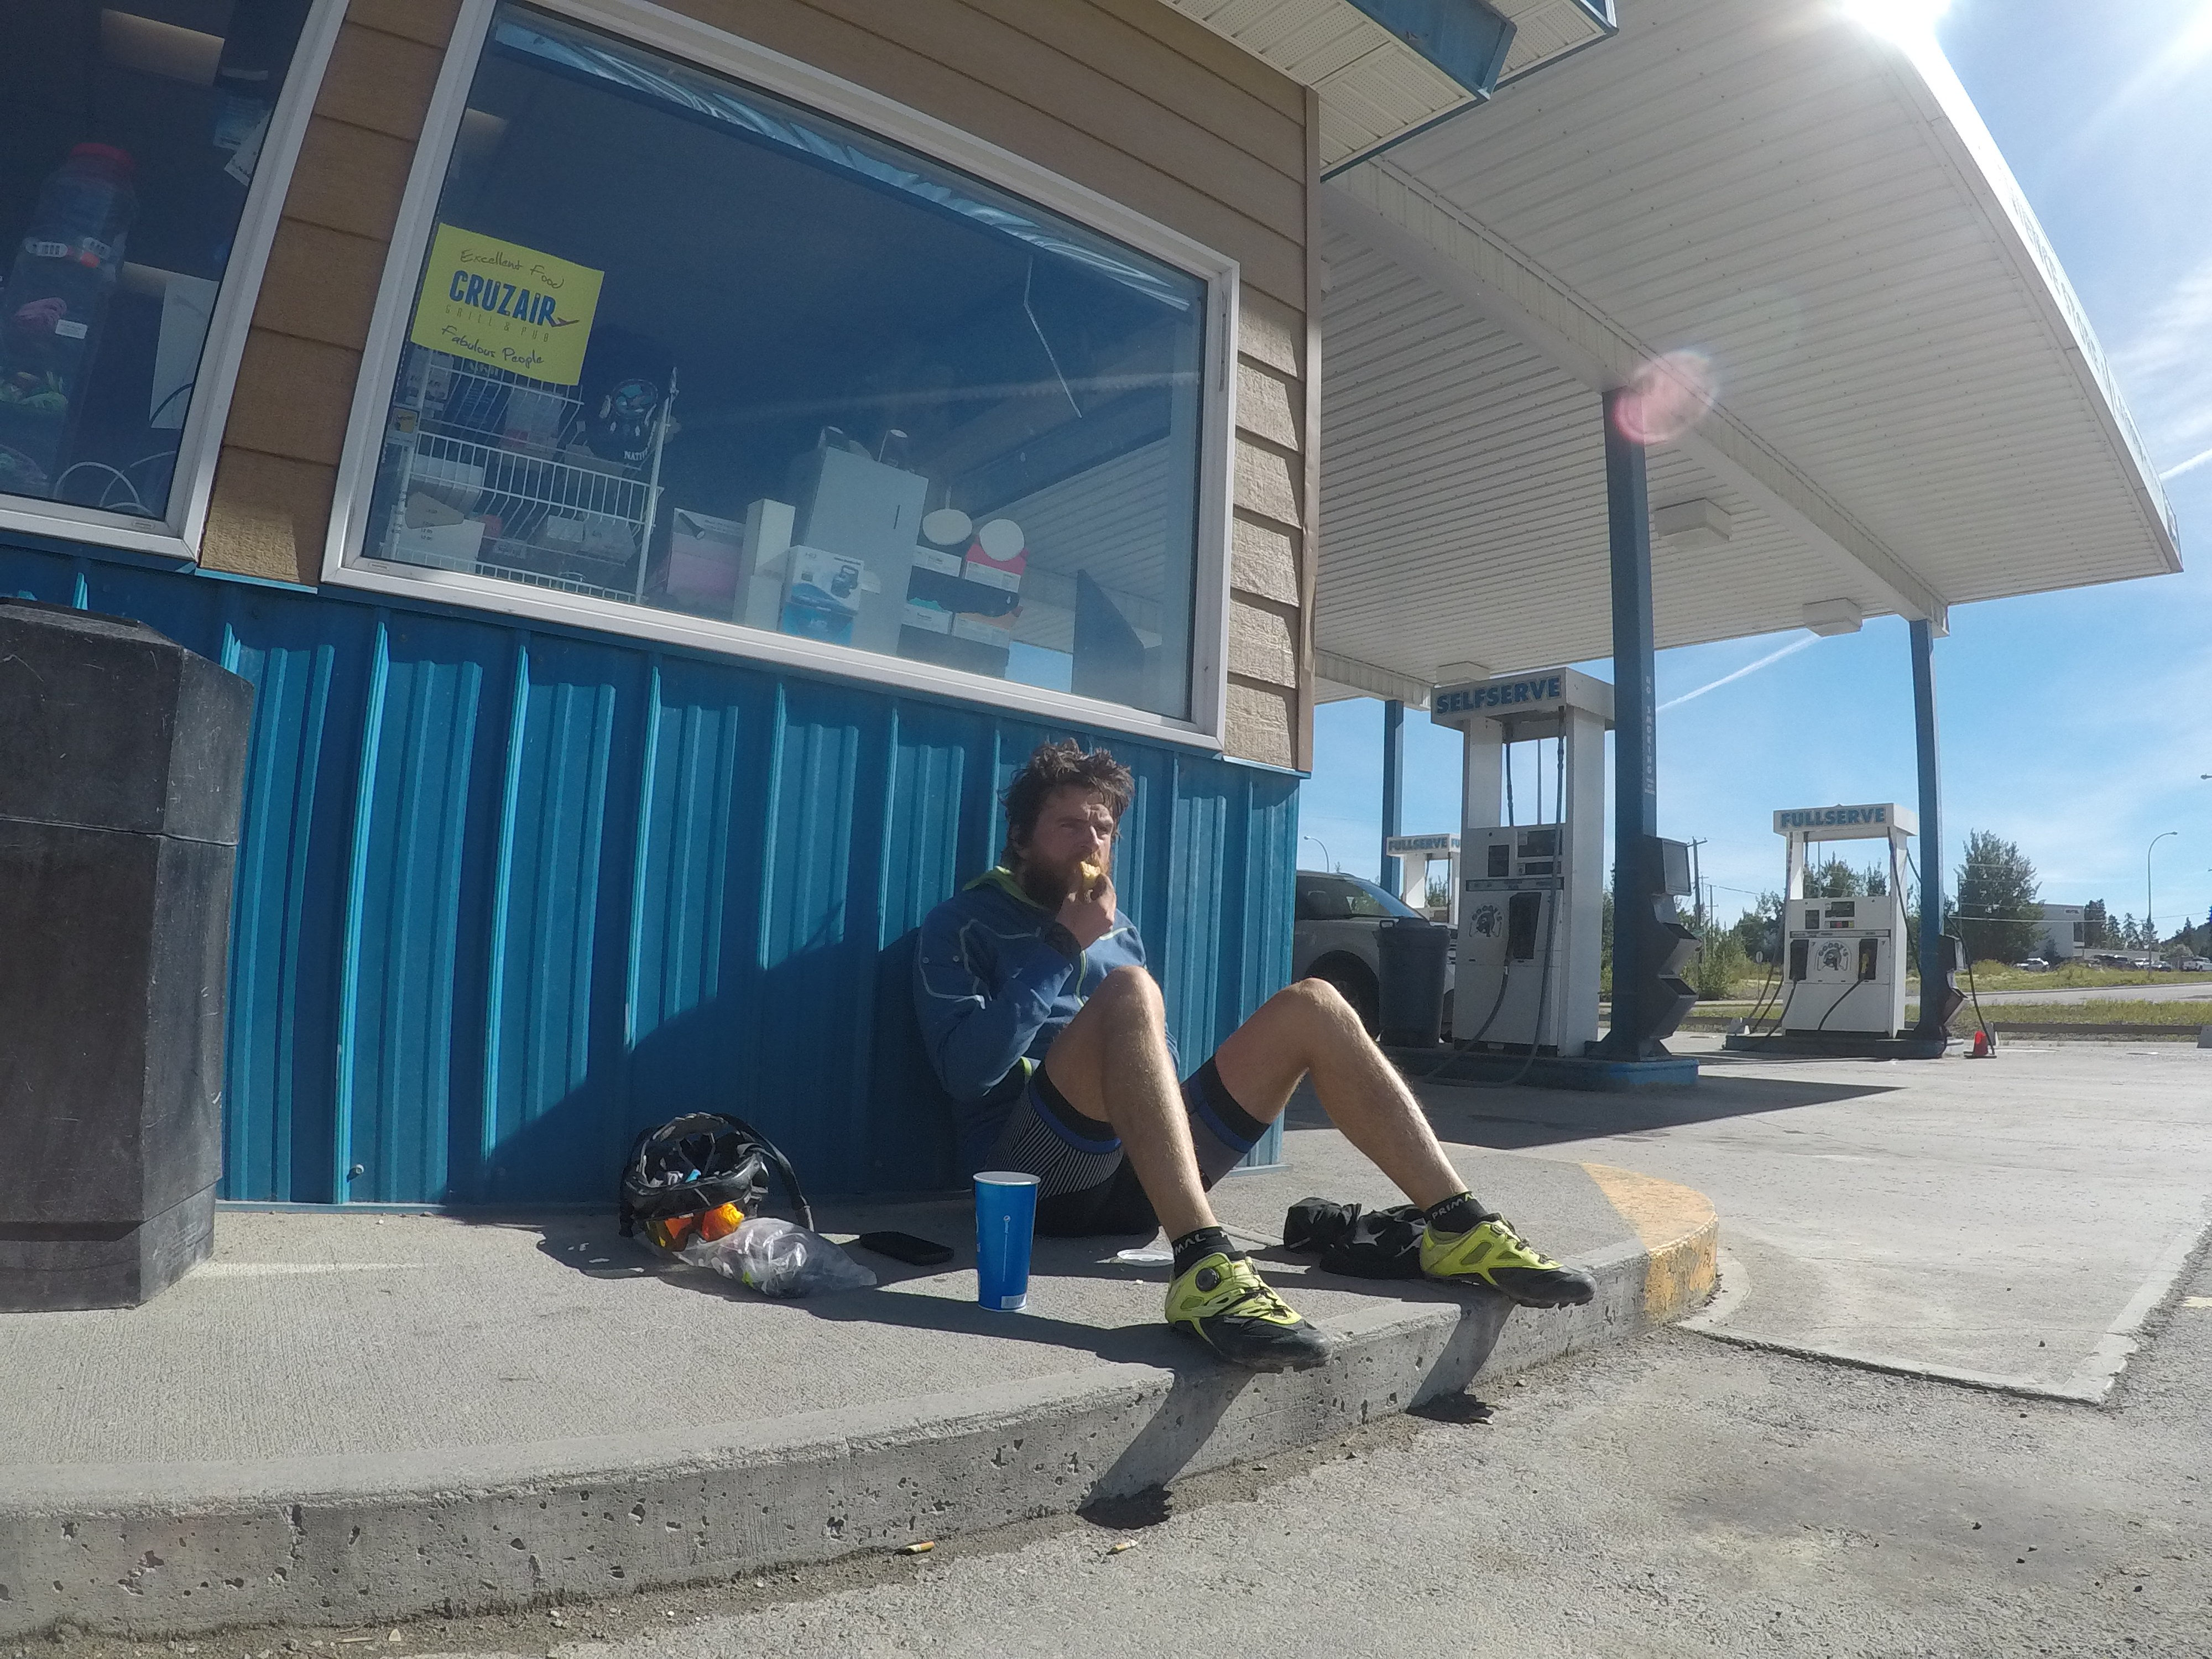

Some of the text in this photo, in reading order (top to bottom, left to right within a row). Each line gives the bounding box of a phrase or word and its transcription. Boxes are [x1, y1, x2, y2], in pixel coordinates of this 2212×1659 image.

[460, 249, 564, 289] Excellent Food
[449, 270, 557, 327] CRUZAIR
[441, 325, 544, 369] Fabulous People
[1437, 677, 1562, 715] SELFSERVE
[1646, 676, 1651, 694] NO
[1780, 808, 1885, 827] FULLSERVE
